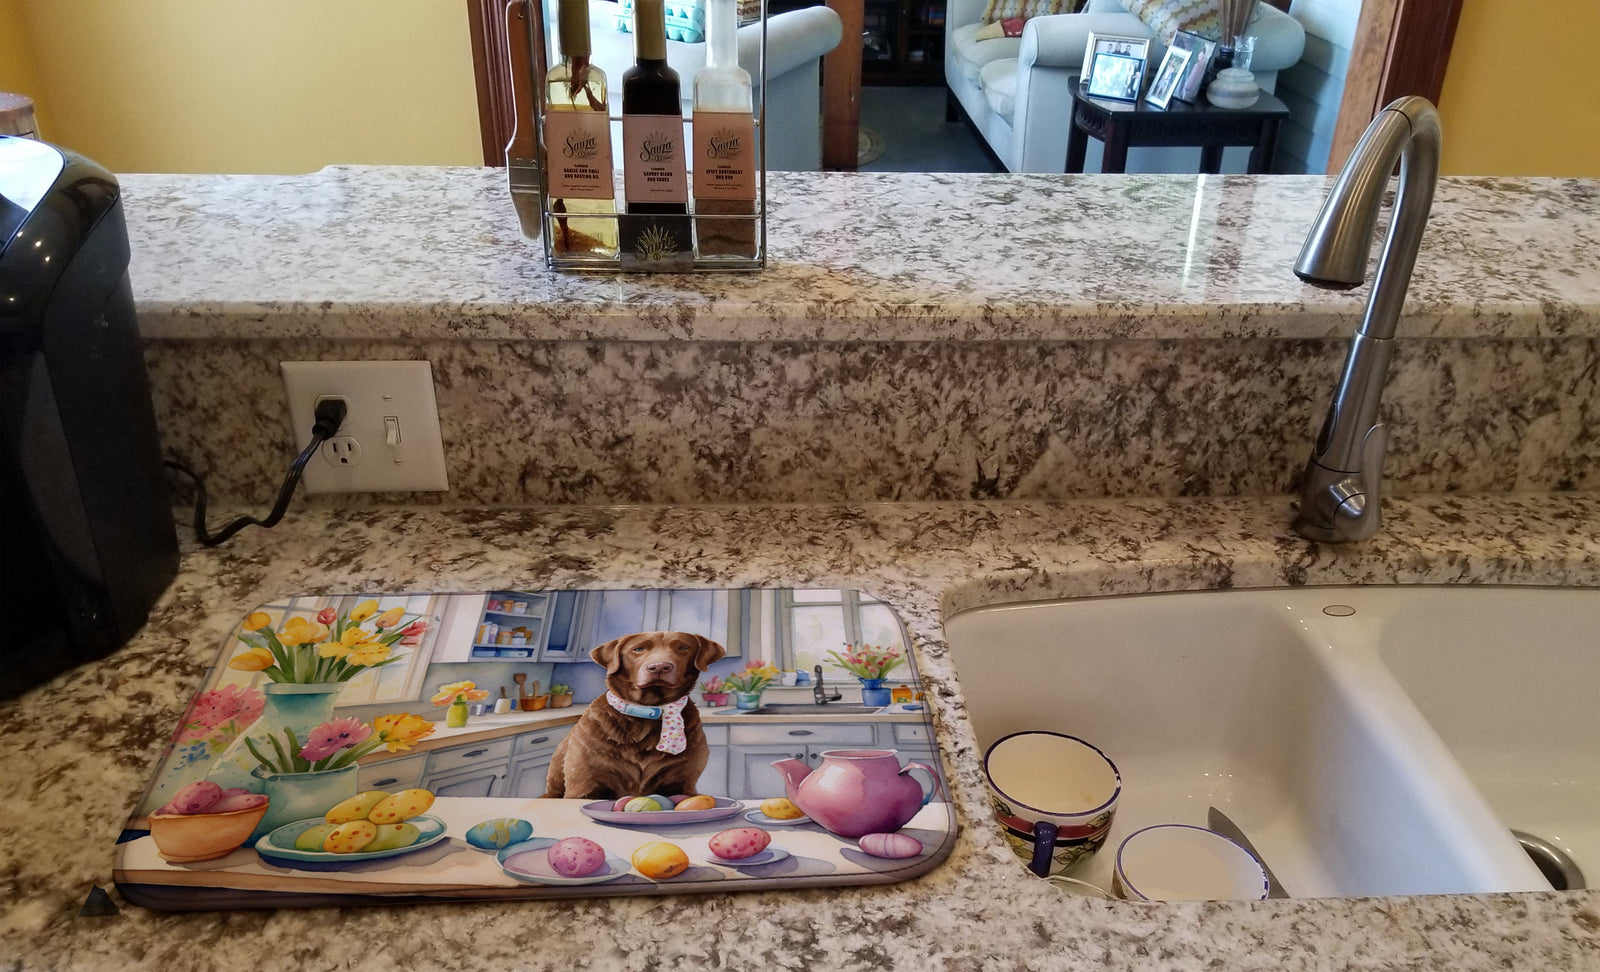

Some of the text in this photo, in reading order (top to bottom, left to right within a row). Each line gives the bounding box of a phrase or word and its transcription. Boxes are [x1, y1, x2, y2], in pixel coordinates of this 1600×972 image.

[562, 136, 597, 158] Sauza
[640, 140, 673, 162] Sauza
[707, 137, 739, 158] Sauza
